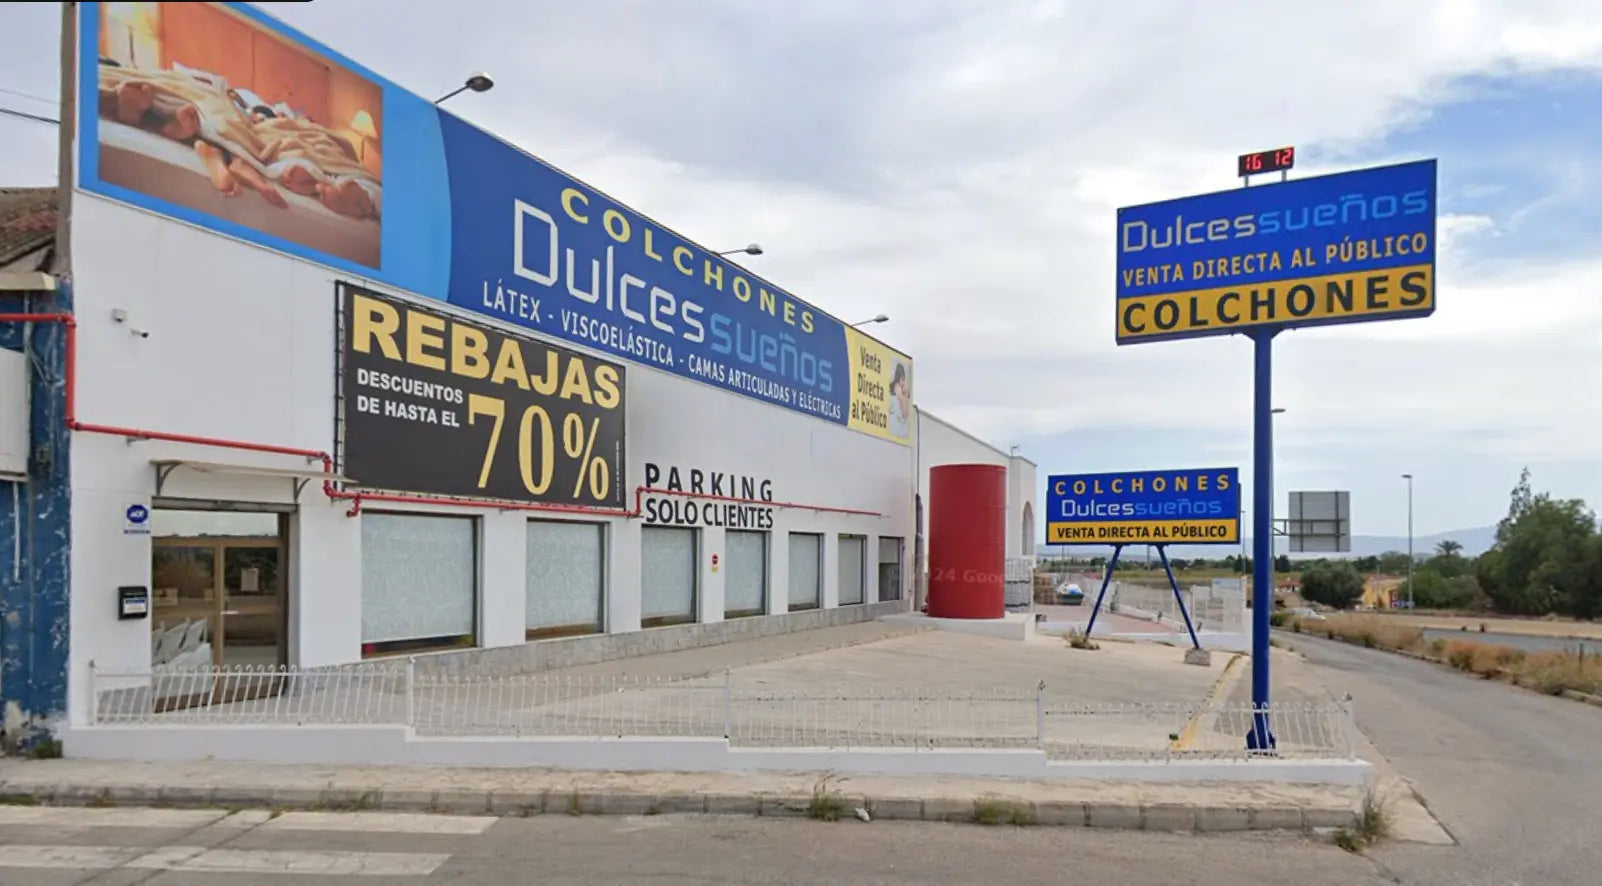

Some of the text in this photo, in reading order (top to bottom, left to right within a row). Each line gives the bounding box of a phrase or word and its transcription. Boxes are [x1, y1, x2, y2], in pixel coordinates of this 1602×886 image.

[561, 188, 814, 334] COLCHONES
[1123, 232, 1427, 288] VENTA DIRECTA AL PÚBLICO
[1123, 271, 1427, 333] COLCHONES
[353, 294, 620, 409] REBAJAS
[483, 278, 540, 323] LÁTEX
[561, 309, 674, 367] VISCOELÁSTICA
[688, 354, 725, 382] CAMAS
[728, 368, 789, 403] ARTICULADAS
[791, 389, 798, 404] Y
[799, 390, 841, 419] ELÉCTRICAS
[860, 345, 882, 373] Venta
[357, 368, 464, 404] DESCUENTOS
[857, 374, 884, 402] Directa
[357, 395, 460, 427] DE HASTA EL
[851, 402, 887, 429] al Público
[468, 393, 610, 500] 70%
[645, 463, 772, 502] PARKING
[1054, 475, 1230, 495] COLCHONES
[645, 498, 773, 529] SOLO CLIENTES
[1057, 522, 1227, 538] VENTA DIRECTA AL PÚBLICO
